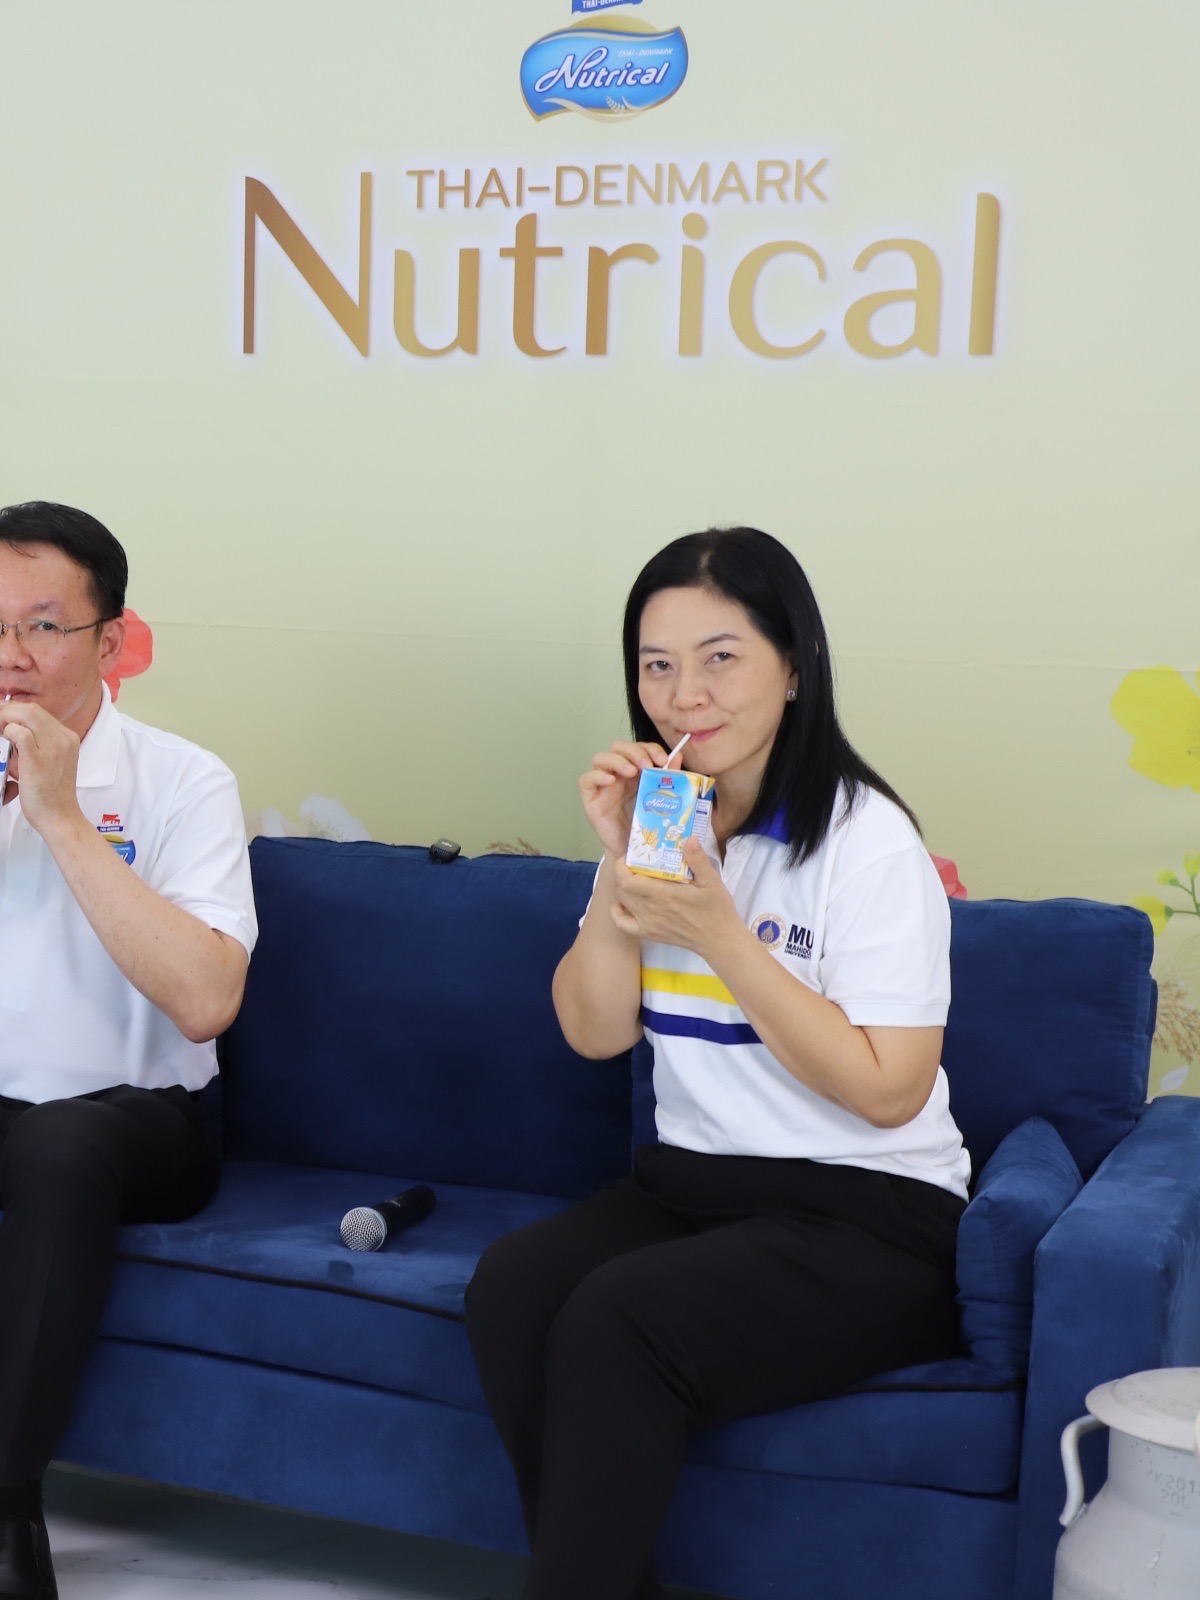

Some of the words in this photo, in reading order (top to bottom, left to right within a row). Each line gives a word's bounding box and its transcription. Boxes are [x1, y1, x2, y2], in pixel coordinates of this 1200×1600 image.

[533, 46, 670, 93] Nutrical
[406, 158, 829, 210] THAI-DENMARK
[243, 171, 1001, 359] Nutrical
[646, 798, 678, 810] Nutrical
[788, 923, 814, 949] MU
